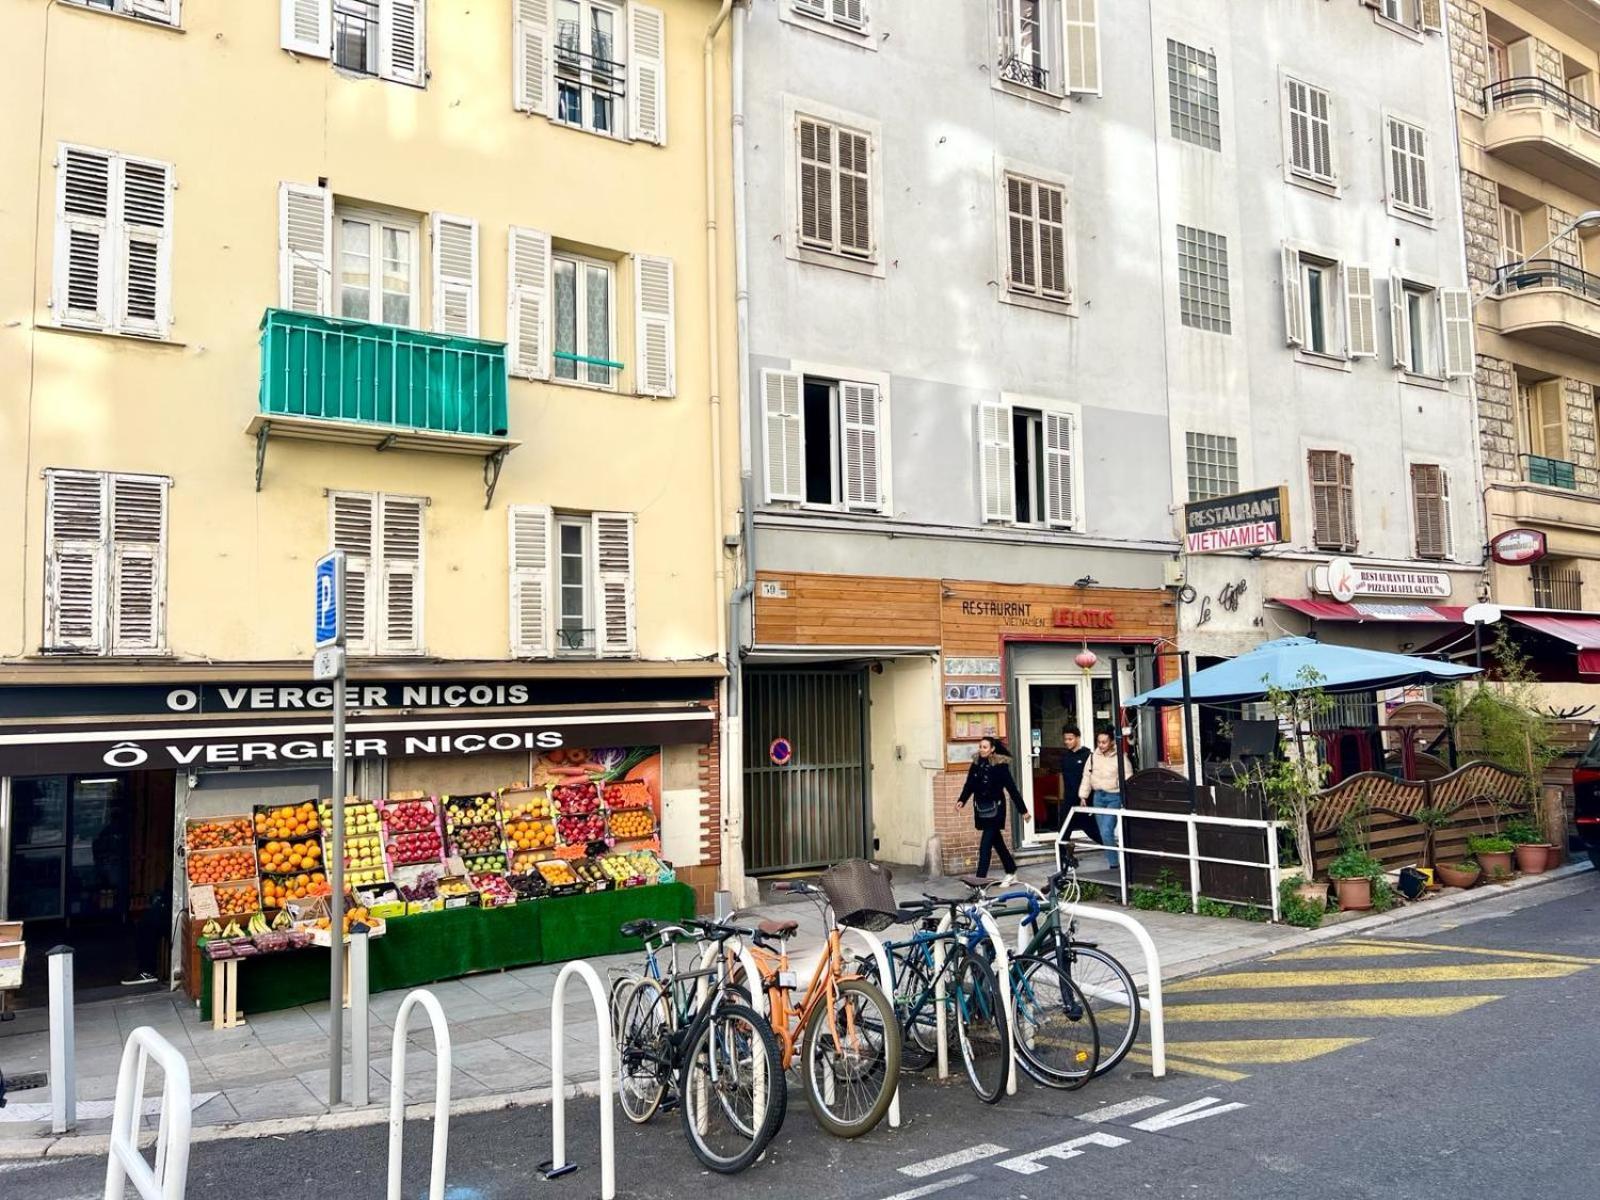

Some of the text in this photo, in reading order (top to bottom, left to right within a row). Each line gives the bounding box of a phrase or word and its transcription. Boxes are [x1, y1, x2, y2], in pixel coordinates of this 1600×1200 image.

[1189, 497, 1280, 527] RESTAURANT
[1187, 524, 1277, 552] VIETNAMIEN
[1361, 571, 1406, 583] RESTAURANT
[321, 575, 332, 628] P
[962, 601, 1032, 617] RESTAURANT
[218, 686, 388, 710] VERGER
[402, 685, 529, 708] NIÇOIS
[103, 731, 564, 767] Ô VERGER NIÇOIS
